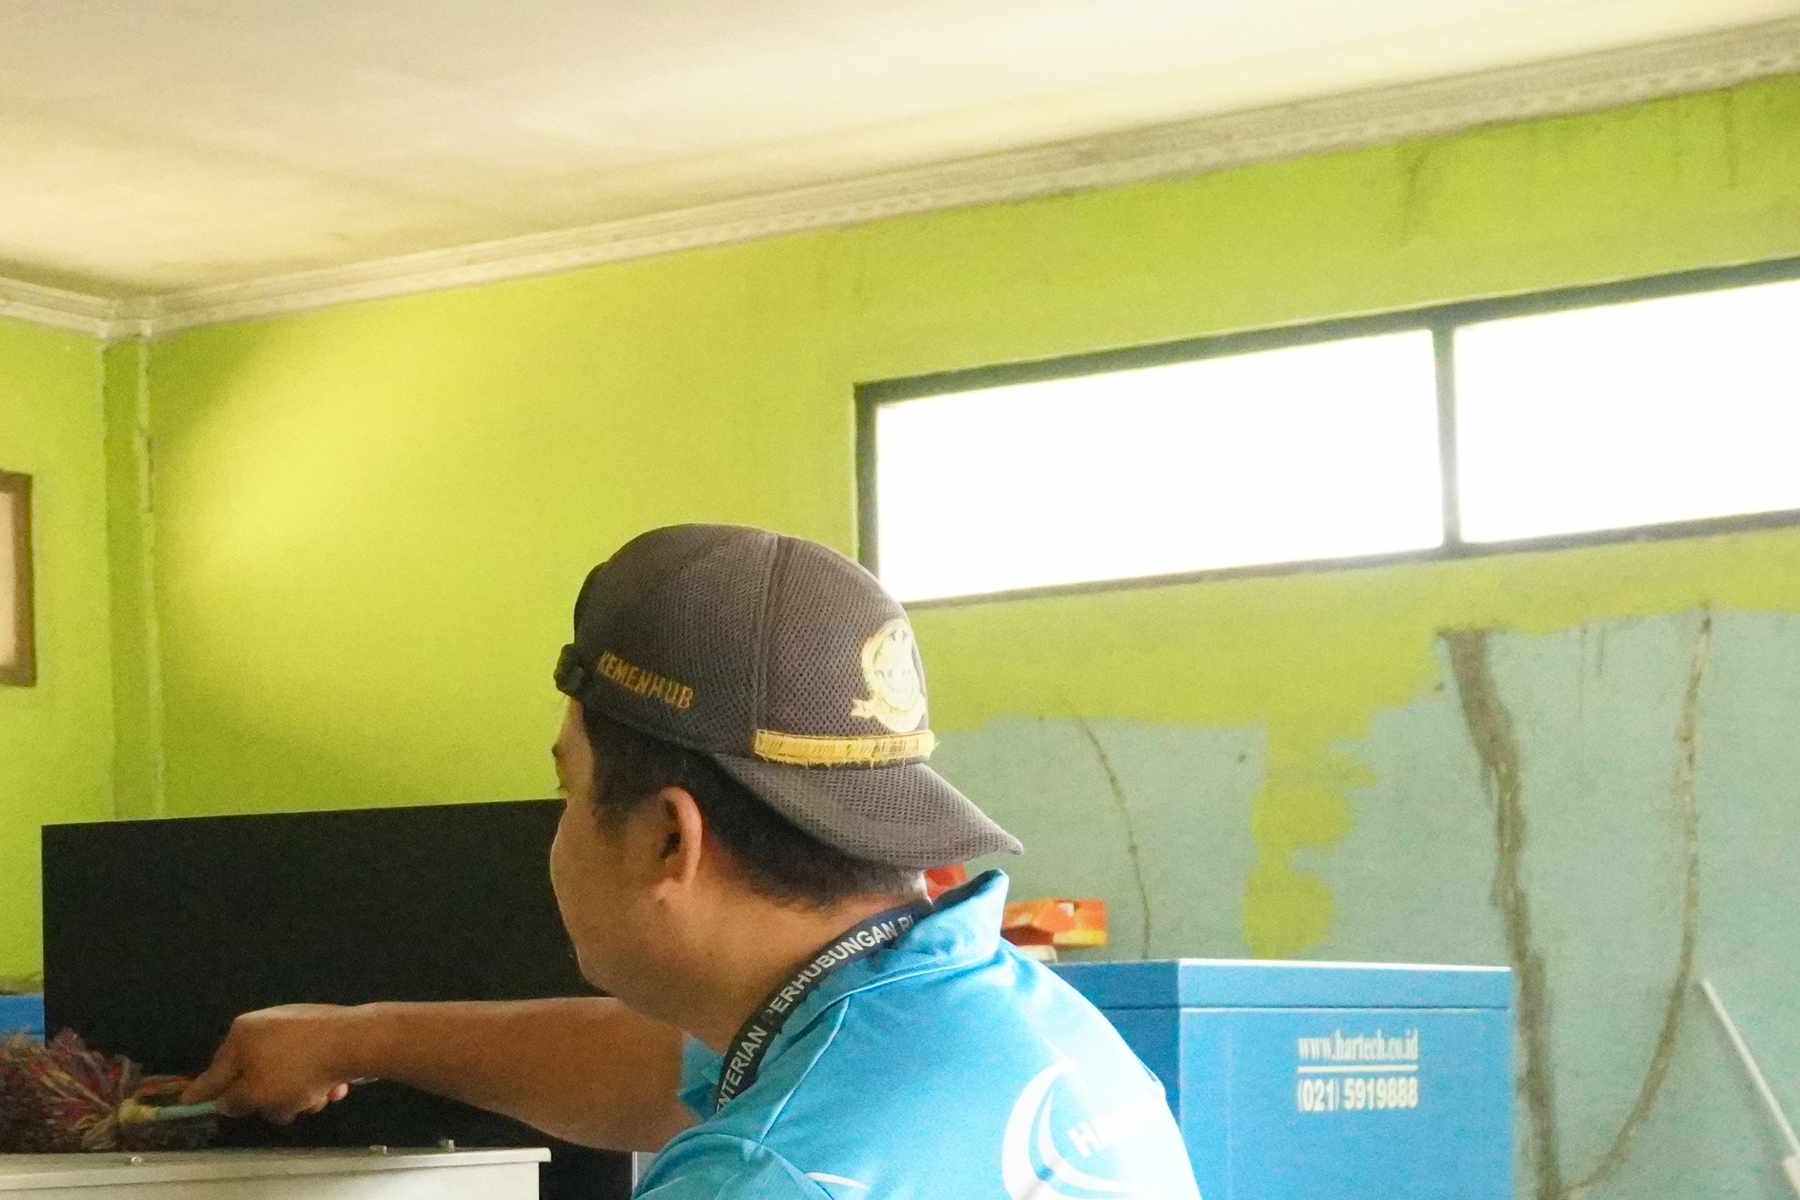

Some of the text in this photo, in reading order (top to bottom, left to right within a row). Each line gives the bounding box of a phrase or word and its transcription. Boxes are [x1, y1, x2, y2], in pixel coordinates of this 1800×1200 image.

[596, 650, 694, 710] KEMENHUB
[1297, 1076, 1418, 1113] (021) 5919888
